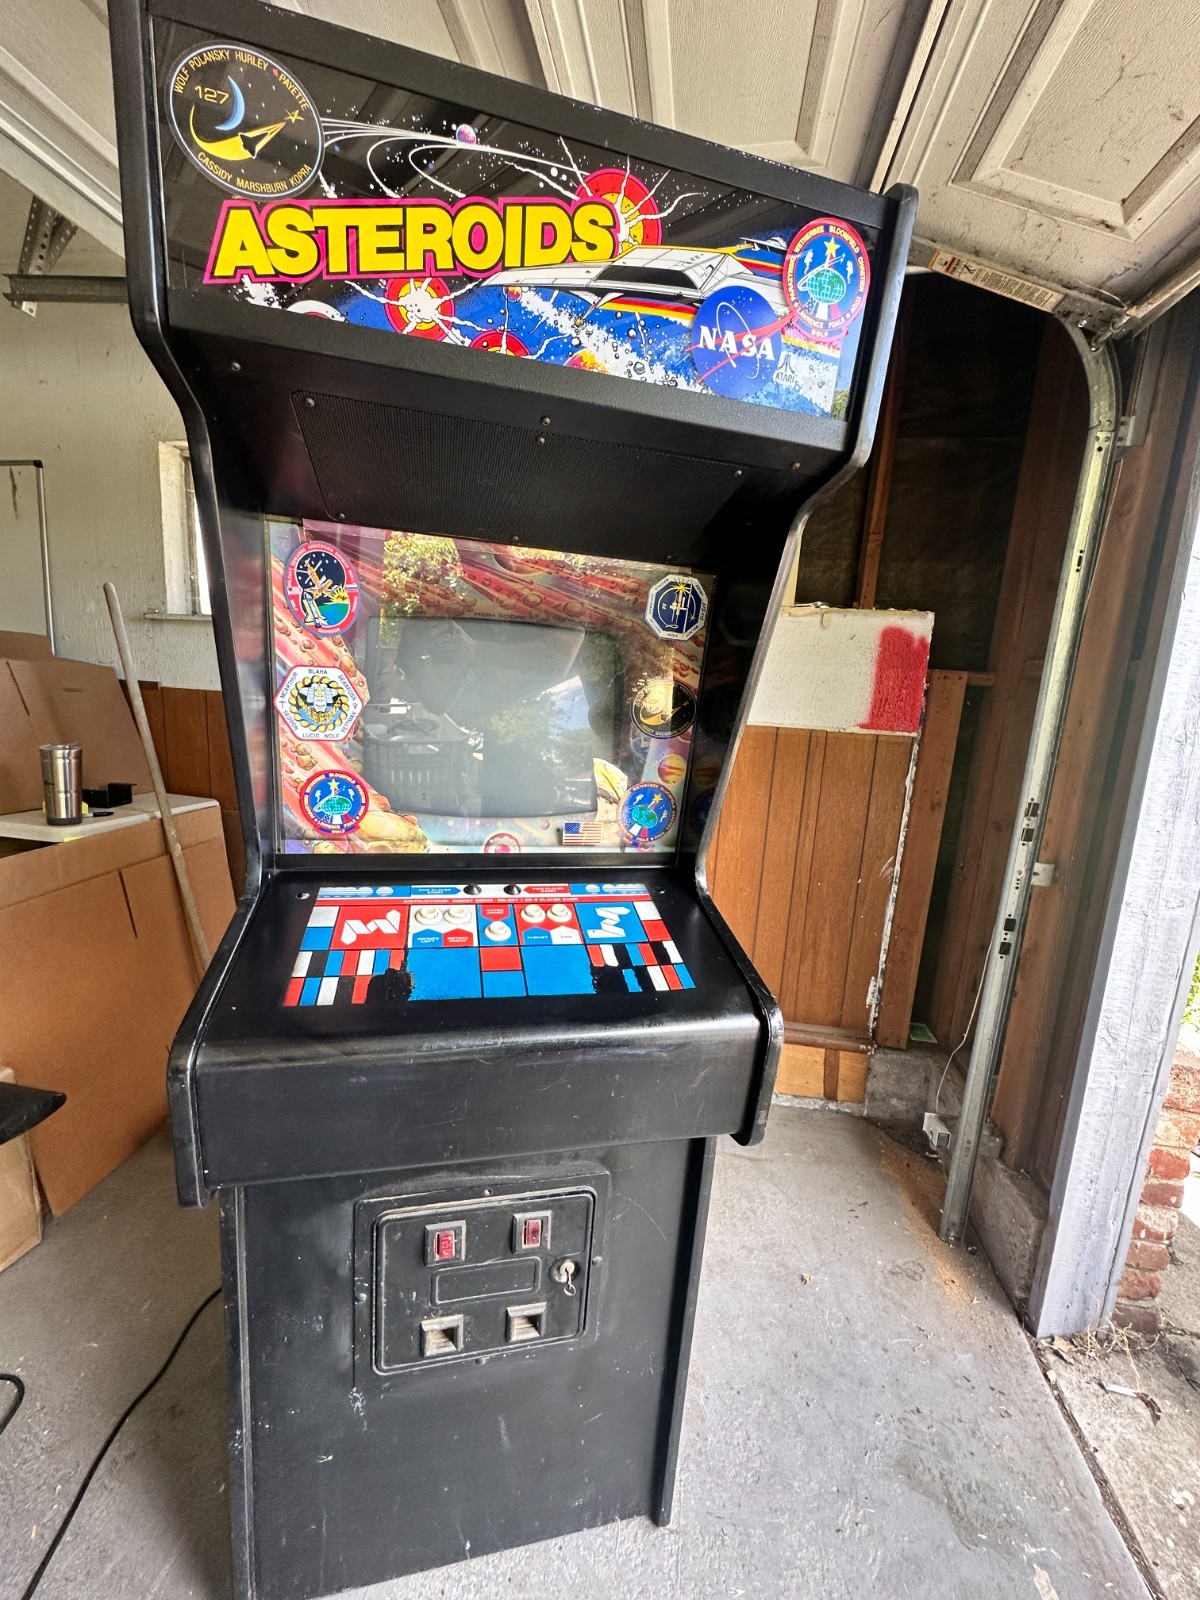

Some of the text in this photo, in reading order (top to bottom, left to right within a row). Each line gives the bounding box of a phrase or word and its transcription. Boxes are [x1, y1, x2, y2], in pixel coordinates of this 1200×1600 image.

[174, 50, 268, 94] WOLF POLANSKY HURLEY
[195, 86, 229, 105] 127
[278, 73, 309, 111] PAYETTE
[197, 152, 312, 193] CASSIDY MARSHBURN KOPRA
[208, 200, 618, 281] ASTEROIDS
[698, 325, 775, 361] NASA
[811, 329, 829, 338] WOLF
[775, 371, 796, 384] ATARI
[338, 674, 357, 701] SEARFOSS
[283, 710, 299, 731] SEDDON
[341, 711, 357, 733] FETTMAN
